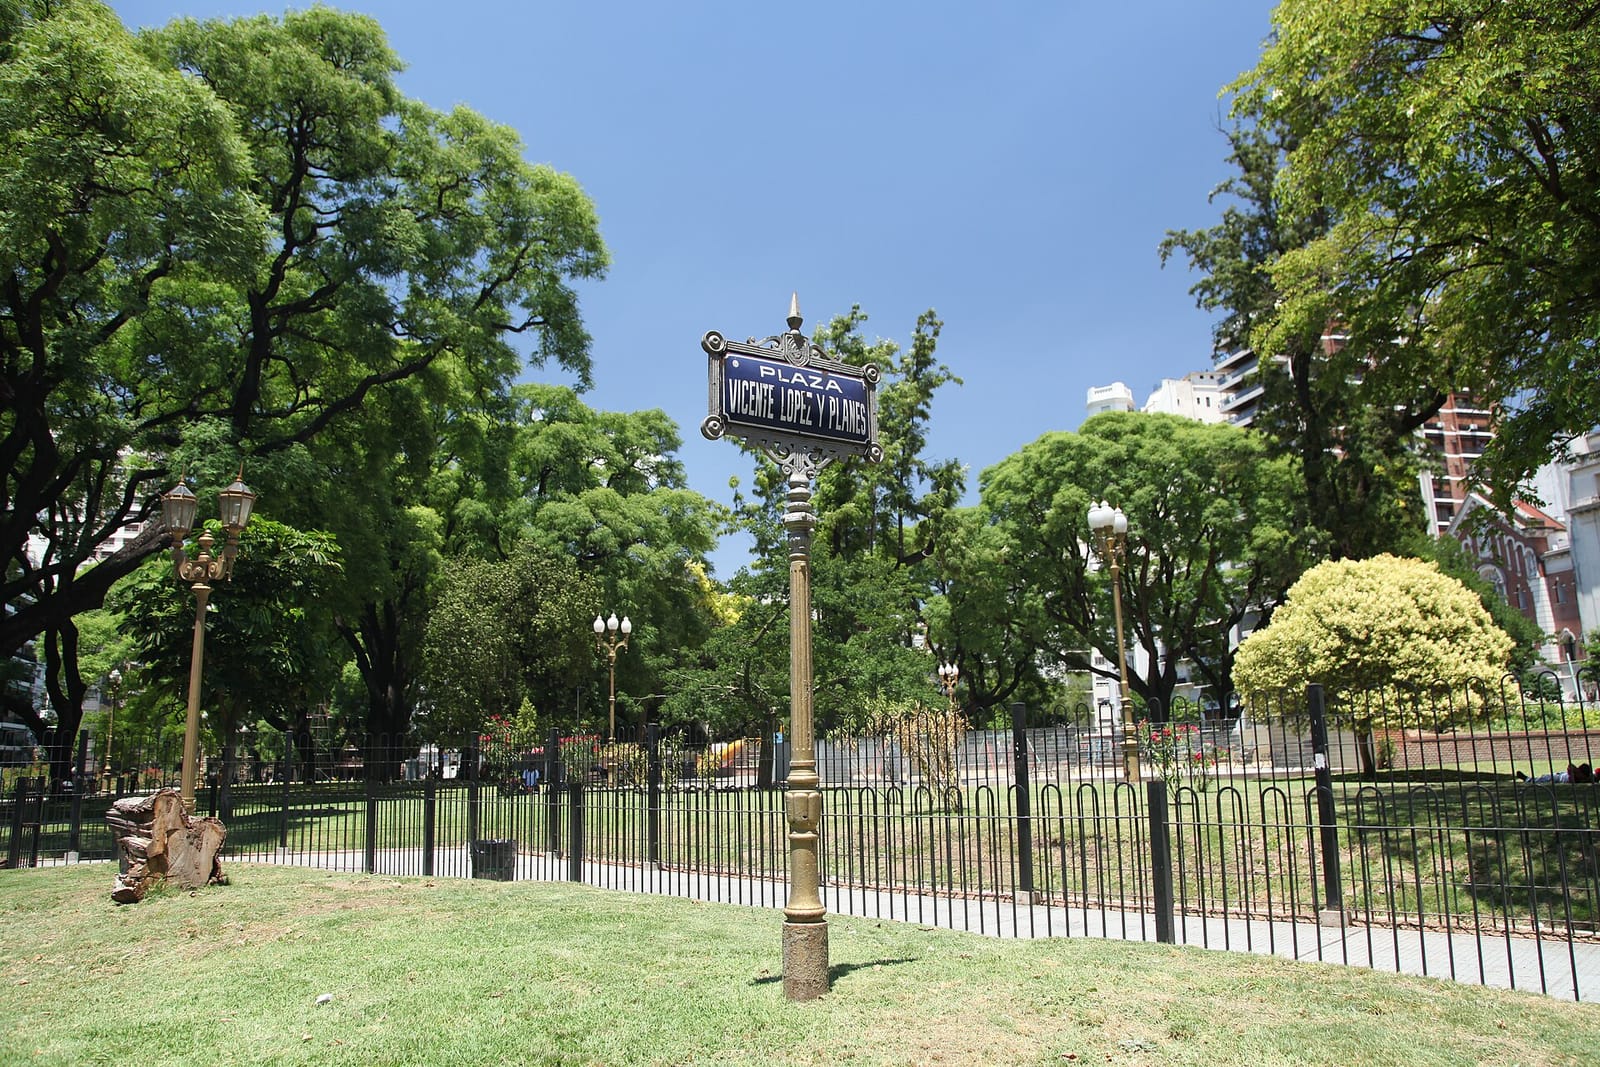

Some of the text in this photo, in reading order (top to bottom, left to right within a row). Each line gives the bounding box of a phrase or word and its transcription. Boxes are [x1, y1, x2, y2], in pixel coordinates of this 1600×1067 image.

[760, 365, 843, 394] PLAZA
[729, 379, 866, 435] VICENTE LOPEZ Y PLANES
